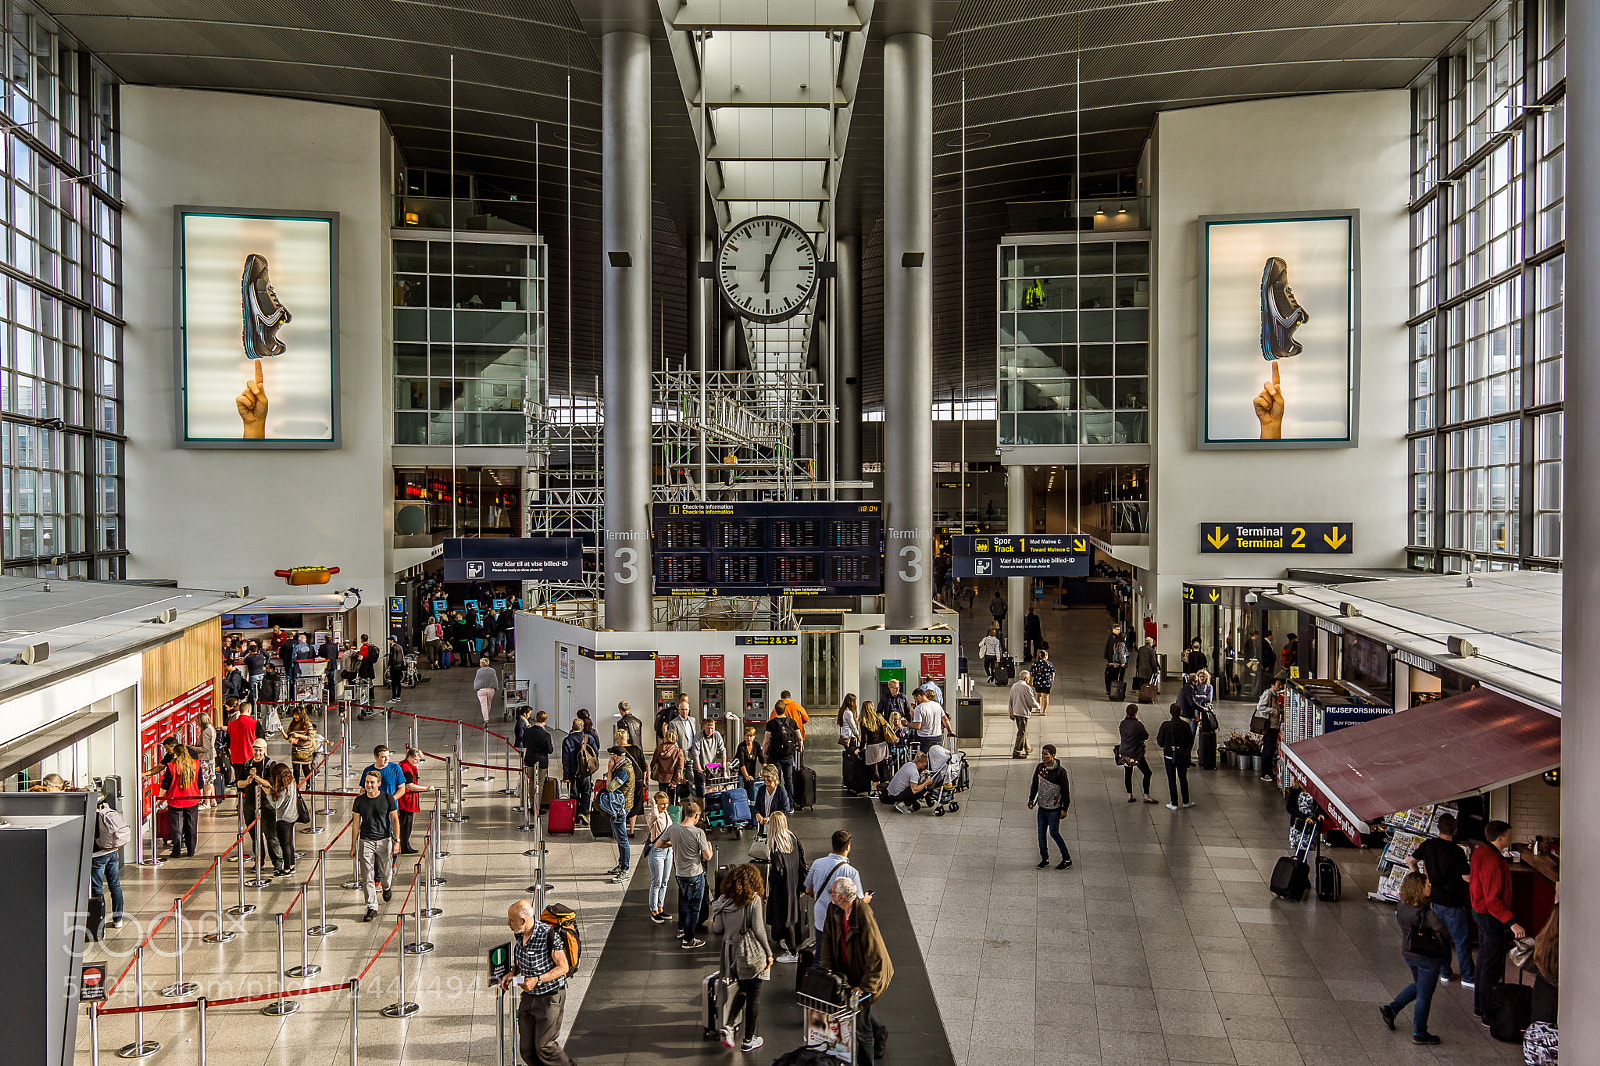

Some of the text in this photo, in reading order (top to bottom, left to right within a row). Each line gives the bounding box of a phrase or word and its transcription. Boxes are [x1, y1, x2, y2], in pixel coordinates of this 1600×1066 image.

[606, 530, 649, 540] Terminal
[888, 528, 932, 539] Terminal
[1236, 526, 1283, 536] Terminal
[994, 537, 1012, 545] Spor
[1236, 528, 1306, 548] Terminal 2
[1019, 538, 1025, 552] 1
[614, 547, 639, 584] 3
[899, 545, 922, 582] 3
[1190, 588, 1194, 599] 2
